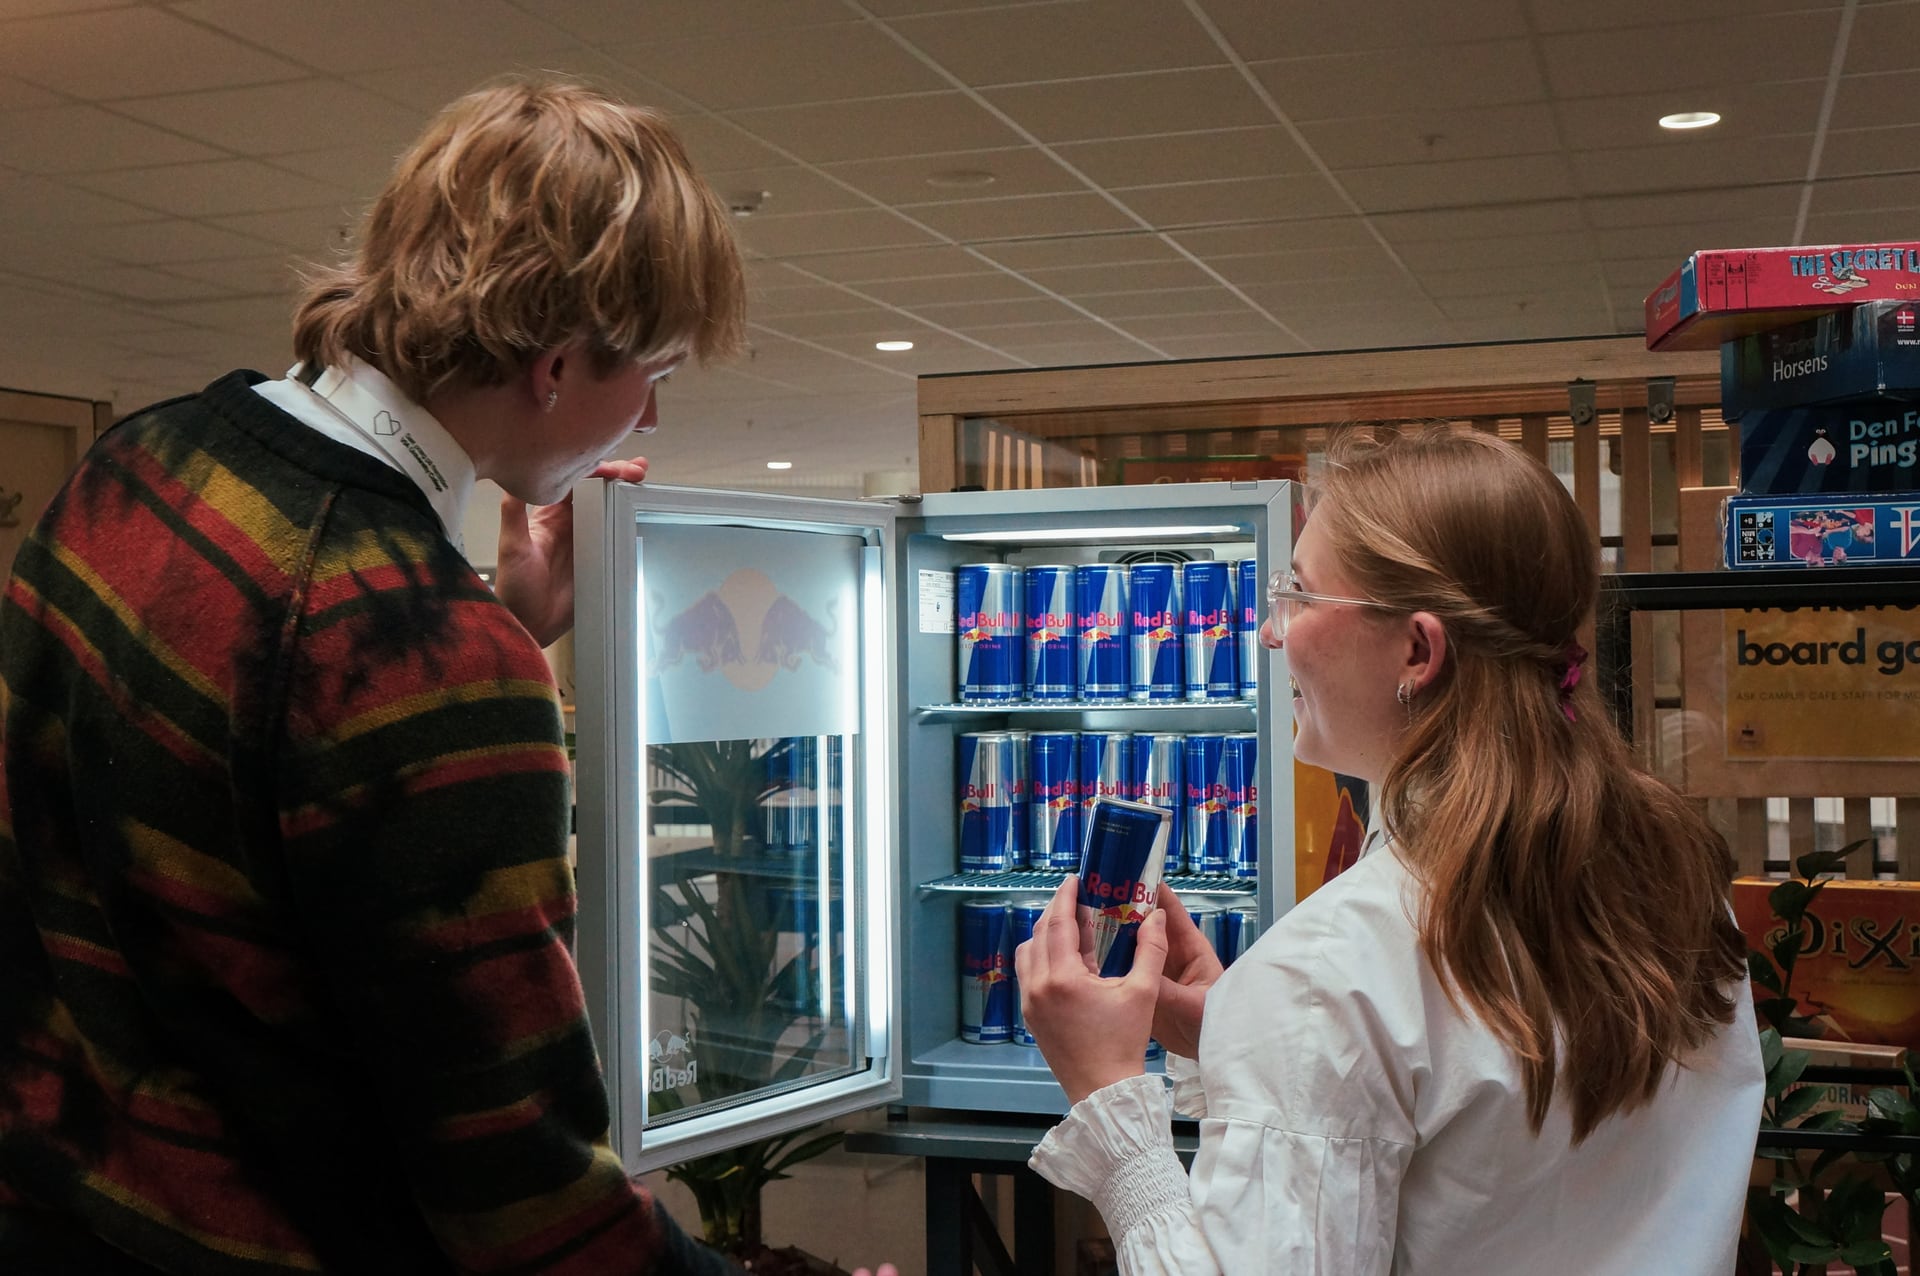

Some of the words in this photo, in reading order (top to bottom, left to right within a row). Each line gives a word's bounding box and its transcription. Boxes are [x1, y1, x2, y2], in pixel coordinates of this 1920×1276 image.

[1789, 254, 1826, 277] THE
[1830, 248, 1905, 278] SECRET
[1773, 355, 1828, 382] Horsens
[1850, 419, 1898, 441] Den
[1850, 439, 1920, 469] Ping
[1046, 612, 1073, 628] Bull
[1097, 612, 1124, 627] Bull
[1134, 611, 1162, 627] Red
[1188, 610, 1218, 626] Red
[1737, 628, 1866, 666] board
[1760, 691, 1805, 701] CAMPUS
[967, 784, 994, 799] Bull
[1034, 781, 1061, 796] Red
[1087, 871, 1130, 900] Red
[1132, 883, 1156, 906] Bu
